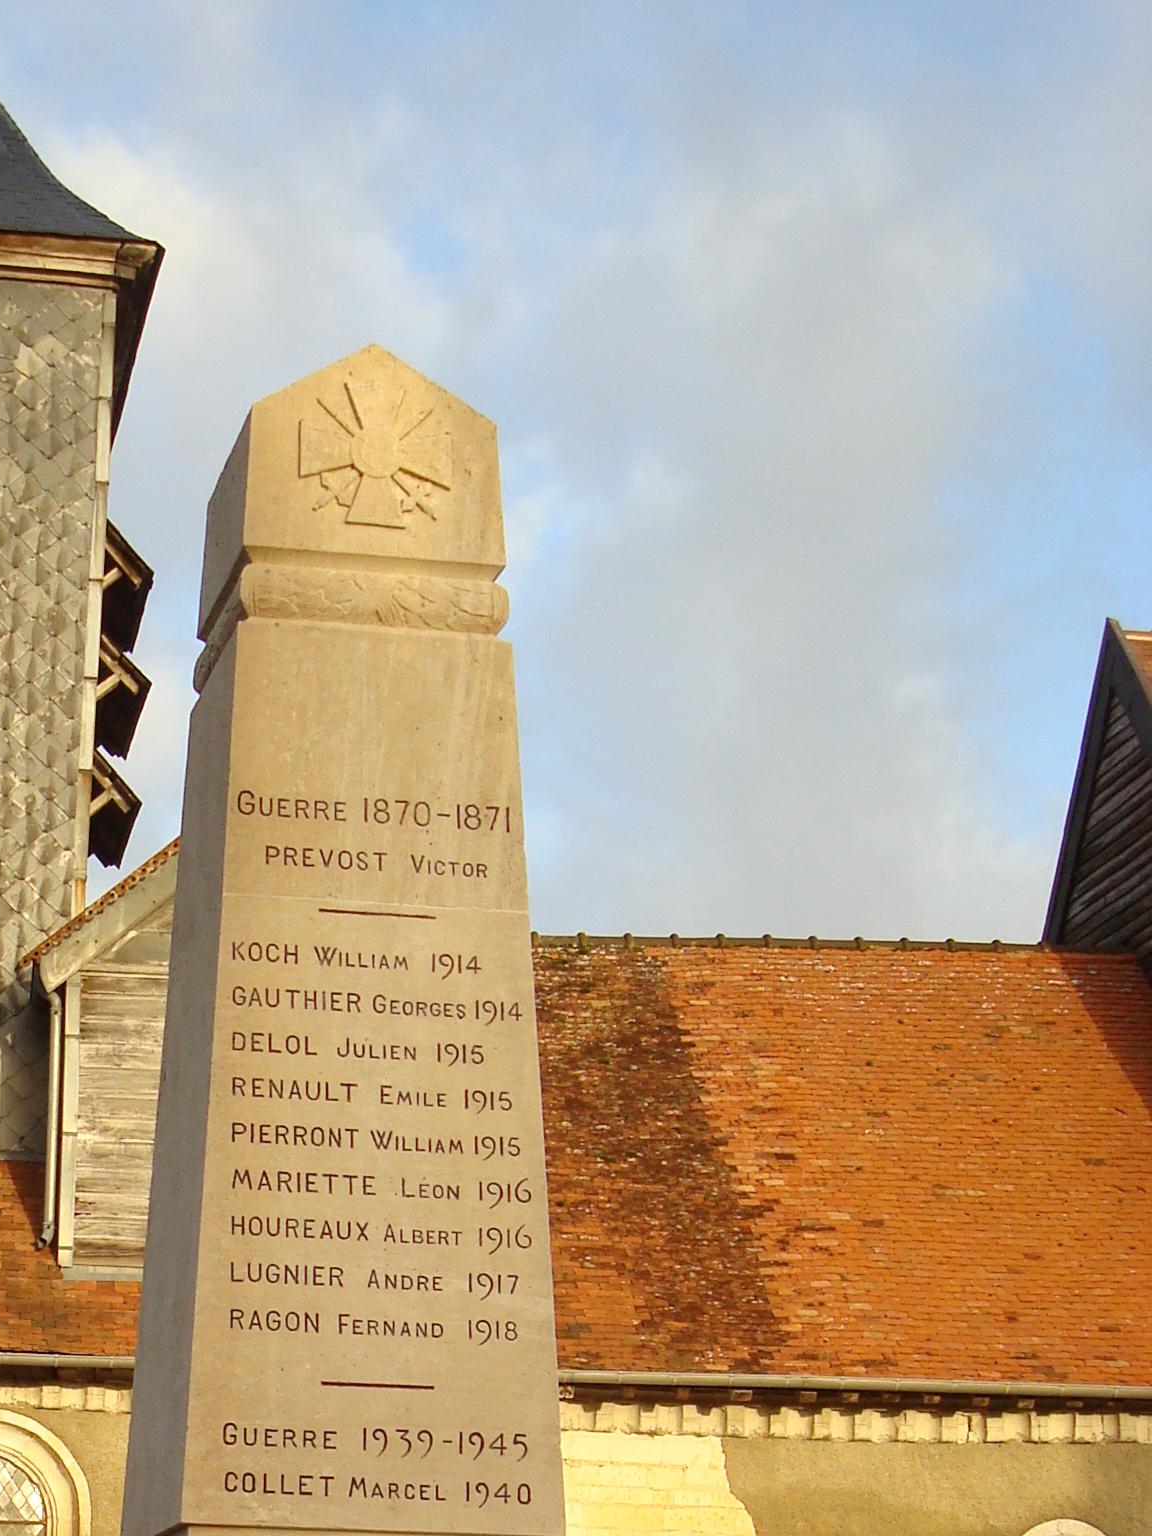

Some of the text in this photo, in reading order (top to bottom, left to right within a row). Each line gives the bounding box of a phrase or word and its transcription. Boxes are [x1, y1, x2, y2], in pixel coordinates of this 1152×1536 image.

[237, 790, 511, 833] GUERRE 1870-1871
[265, 846, 488, 878] PREVOST VICTOR
[232, 942, 482, 979] KOCH WILLIAM 1914
[232, 986, 523, 1025] GAUTHIER GEORGES 1914
[232, 1032, 485, 1066] DELOL JULIEN 1915
[232, 1077, 358, 1103] RENAULT
[464, 1089, 512, 1114] 1915
[231, 1122, 520, 1160] PIERRONT WILLIAM 1915
[232, 1169, 376, 1196] MARIETTE
[478, 1178, 532, 1209] 1916
[231, 1216, 532, 1255] HOUREAUX ALBERT 1916
[230, 1262, 344, 1287] LUGNIER
[468, 1273, 519, 1300] 1917
[230, 1309, 518, 1345] RAGON FERNAND 1918
[223, 1423, 528, 1461] GUERRE 1939-1945
[224, 1472, 532, 1508] COLLET MARCEL 1940
